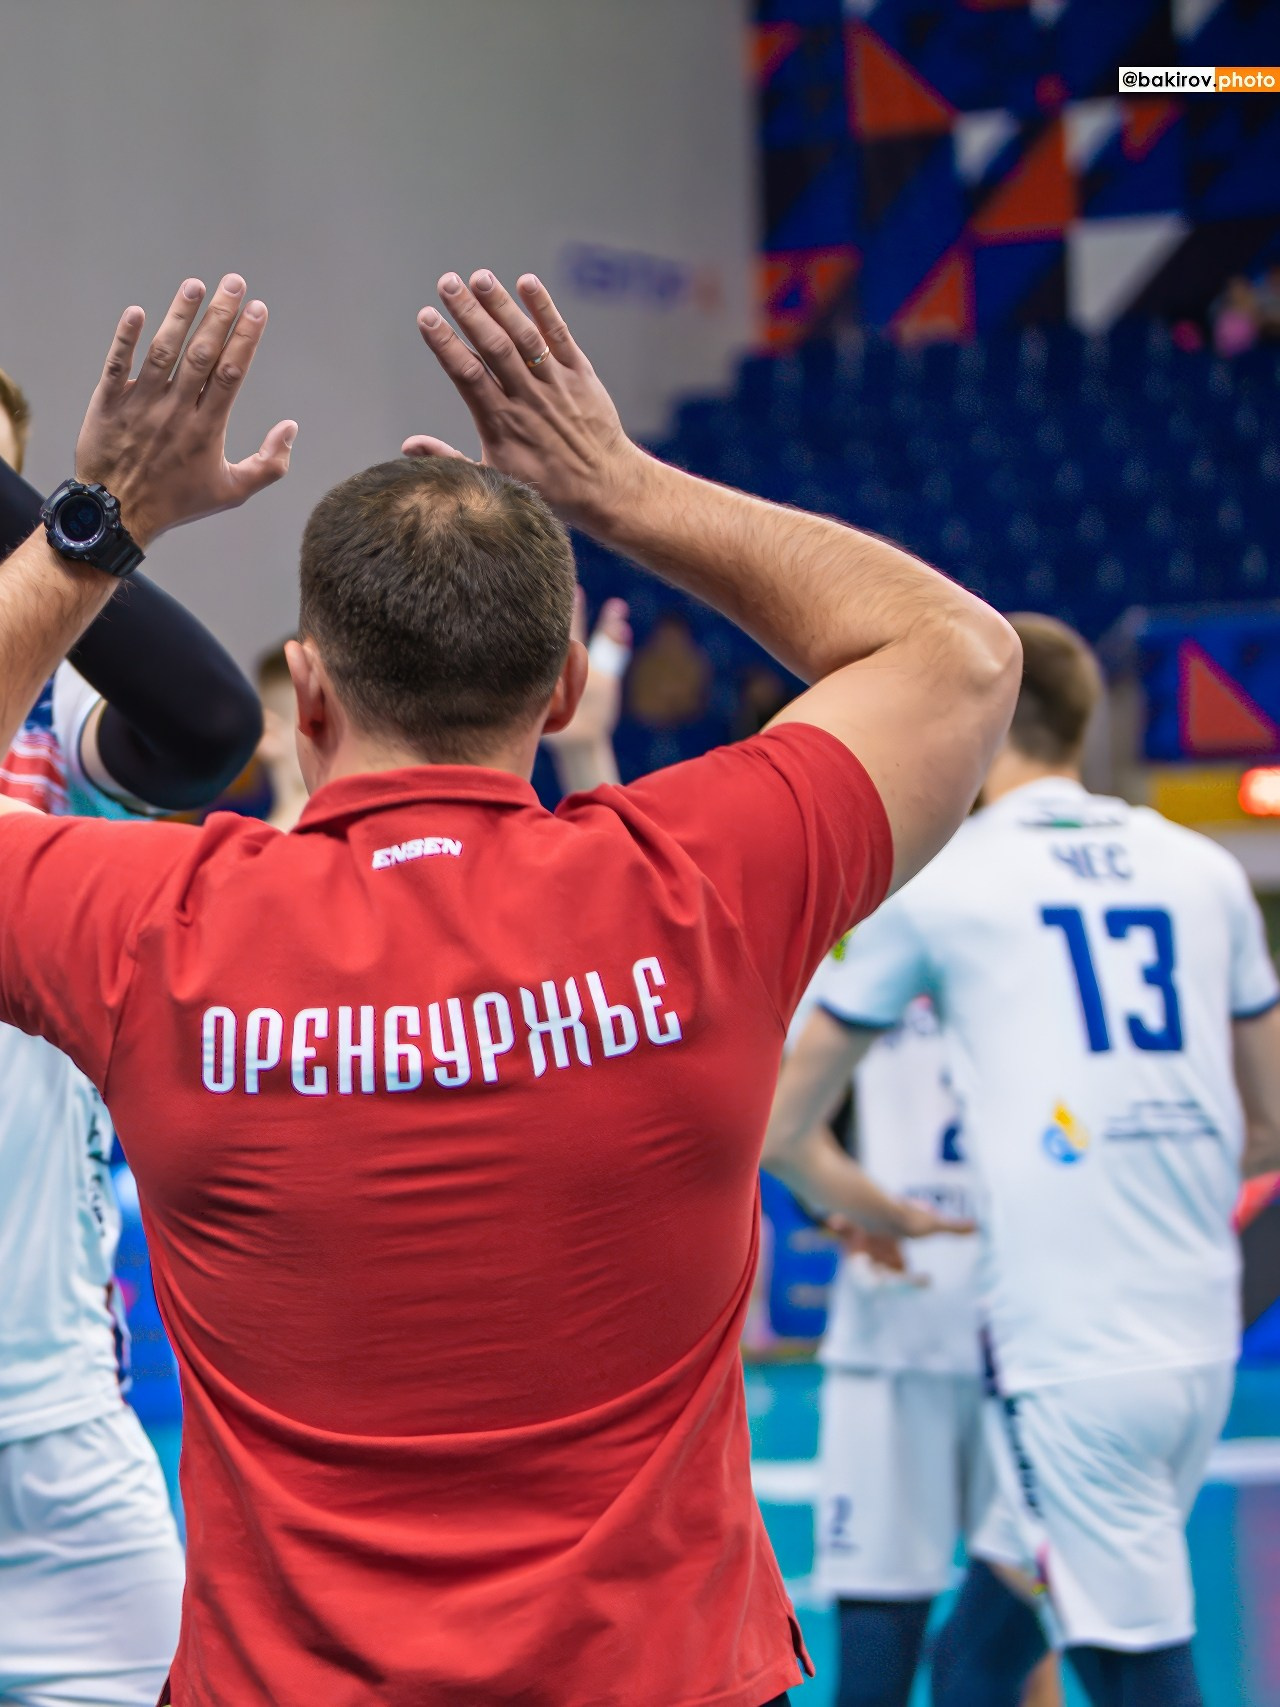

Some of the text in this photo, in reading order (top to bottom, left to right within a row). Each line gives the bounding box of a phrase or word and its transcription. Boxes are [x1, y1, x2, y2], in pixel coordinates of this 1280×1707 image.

[372, 837, 463, 870] ENSEN
[202, 956, 683, 1096] ОРЕНБУРЖЬЕ
[1041, 906, 1183, 1051] 13
